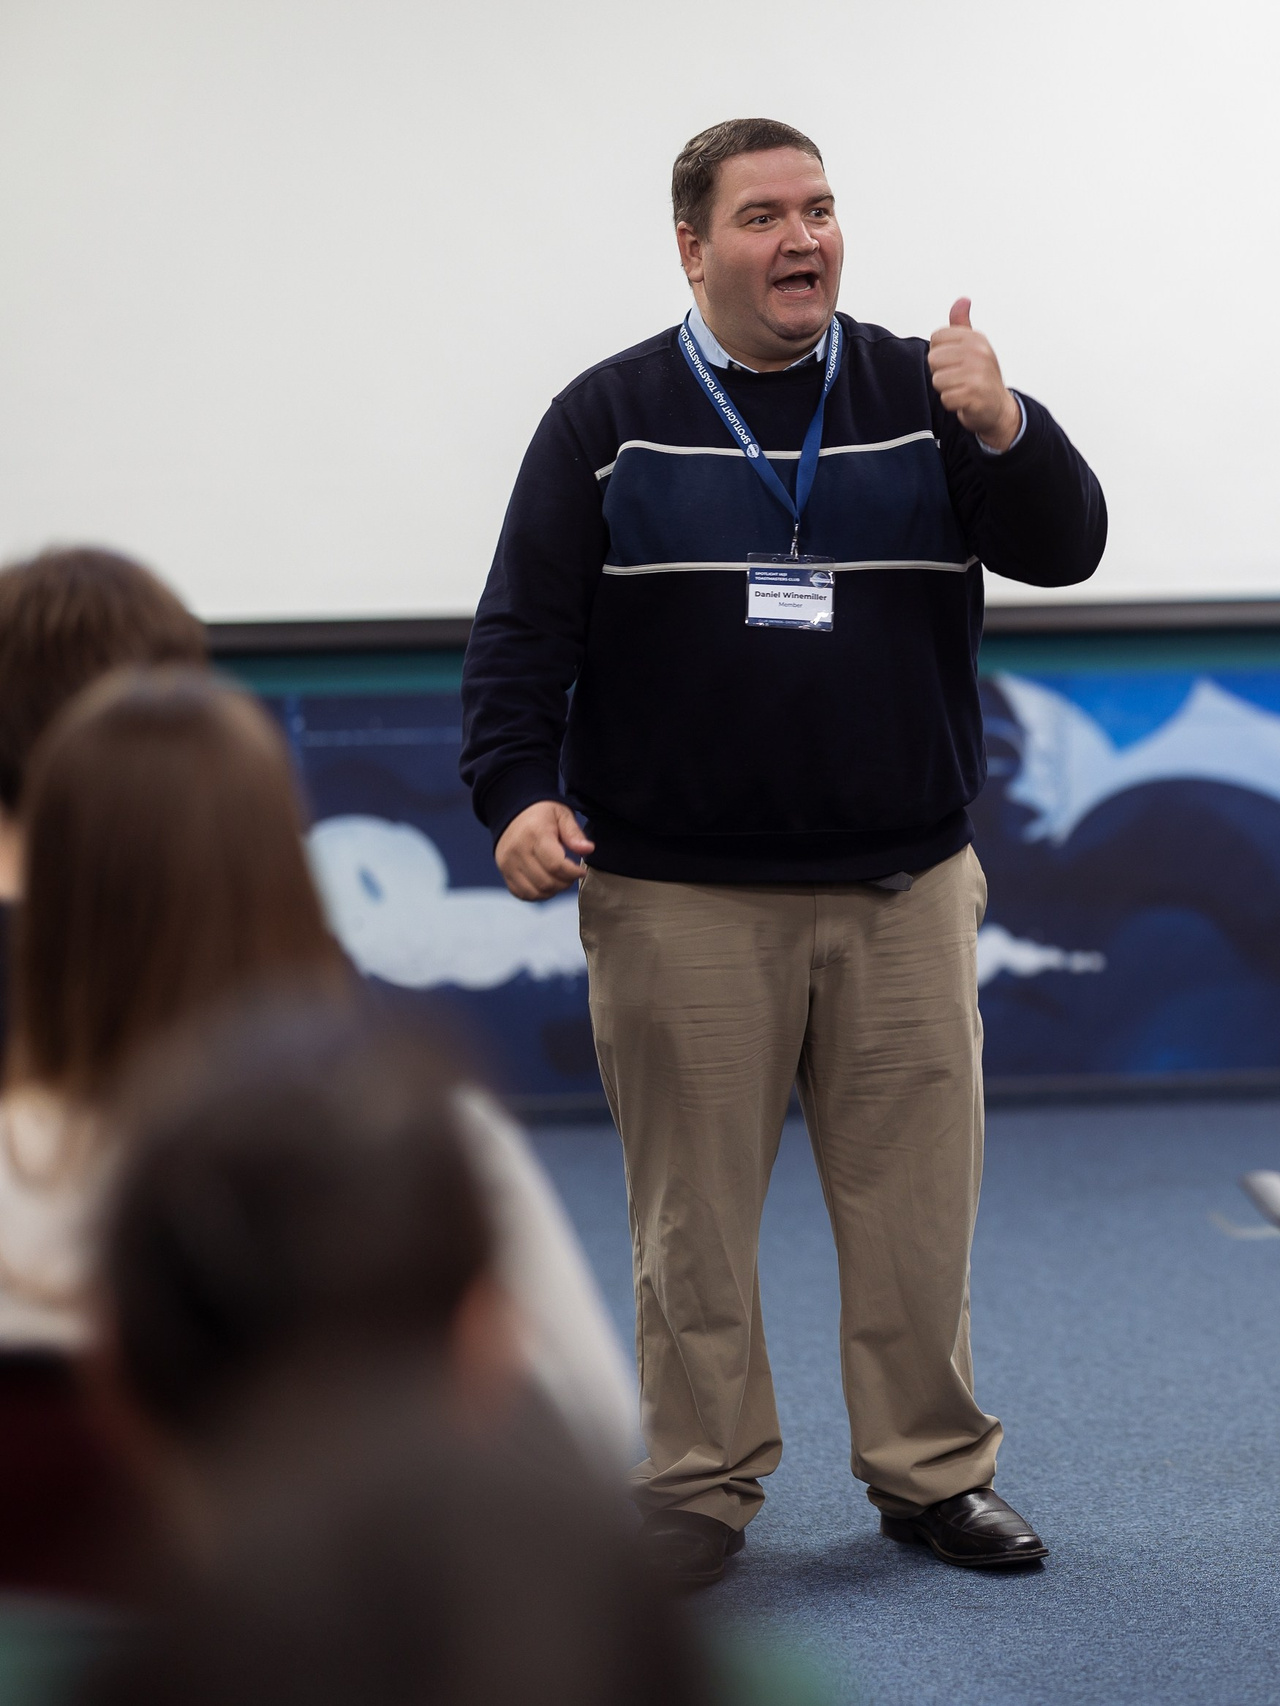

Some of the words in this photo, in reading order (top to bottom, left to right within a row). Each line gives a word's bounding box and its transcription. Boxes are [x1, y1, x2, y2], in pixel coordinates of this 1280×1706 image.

[685, 340, 718, 393] TOASTMASTERS
[826, 330, 839, 382] TOASTMASTERS
[721, 405, 752, 445] SPOTLIGHT
[782, 591, 828, 601] Winemiller
